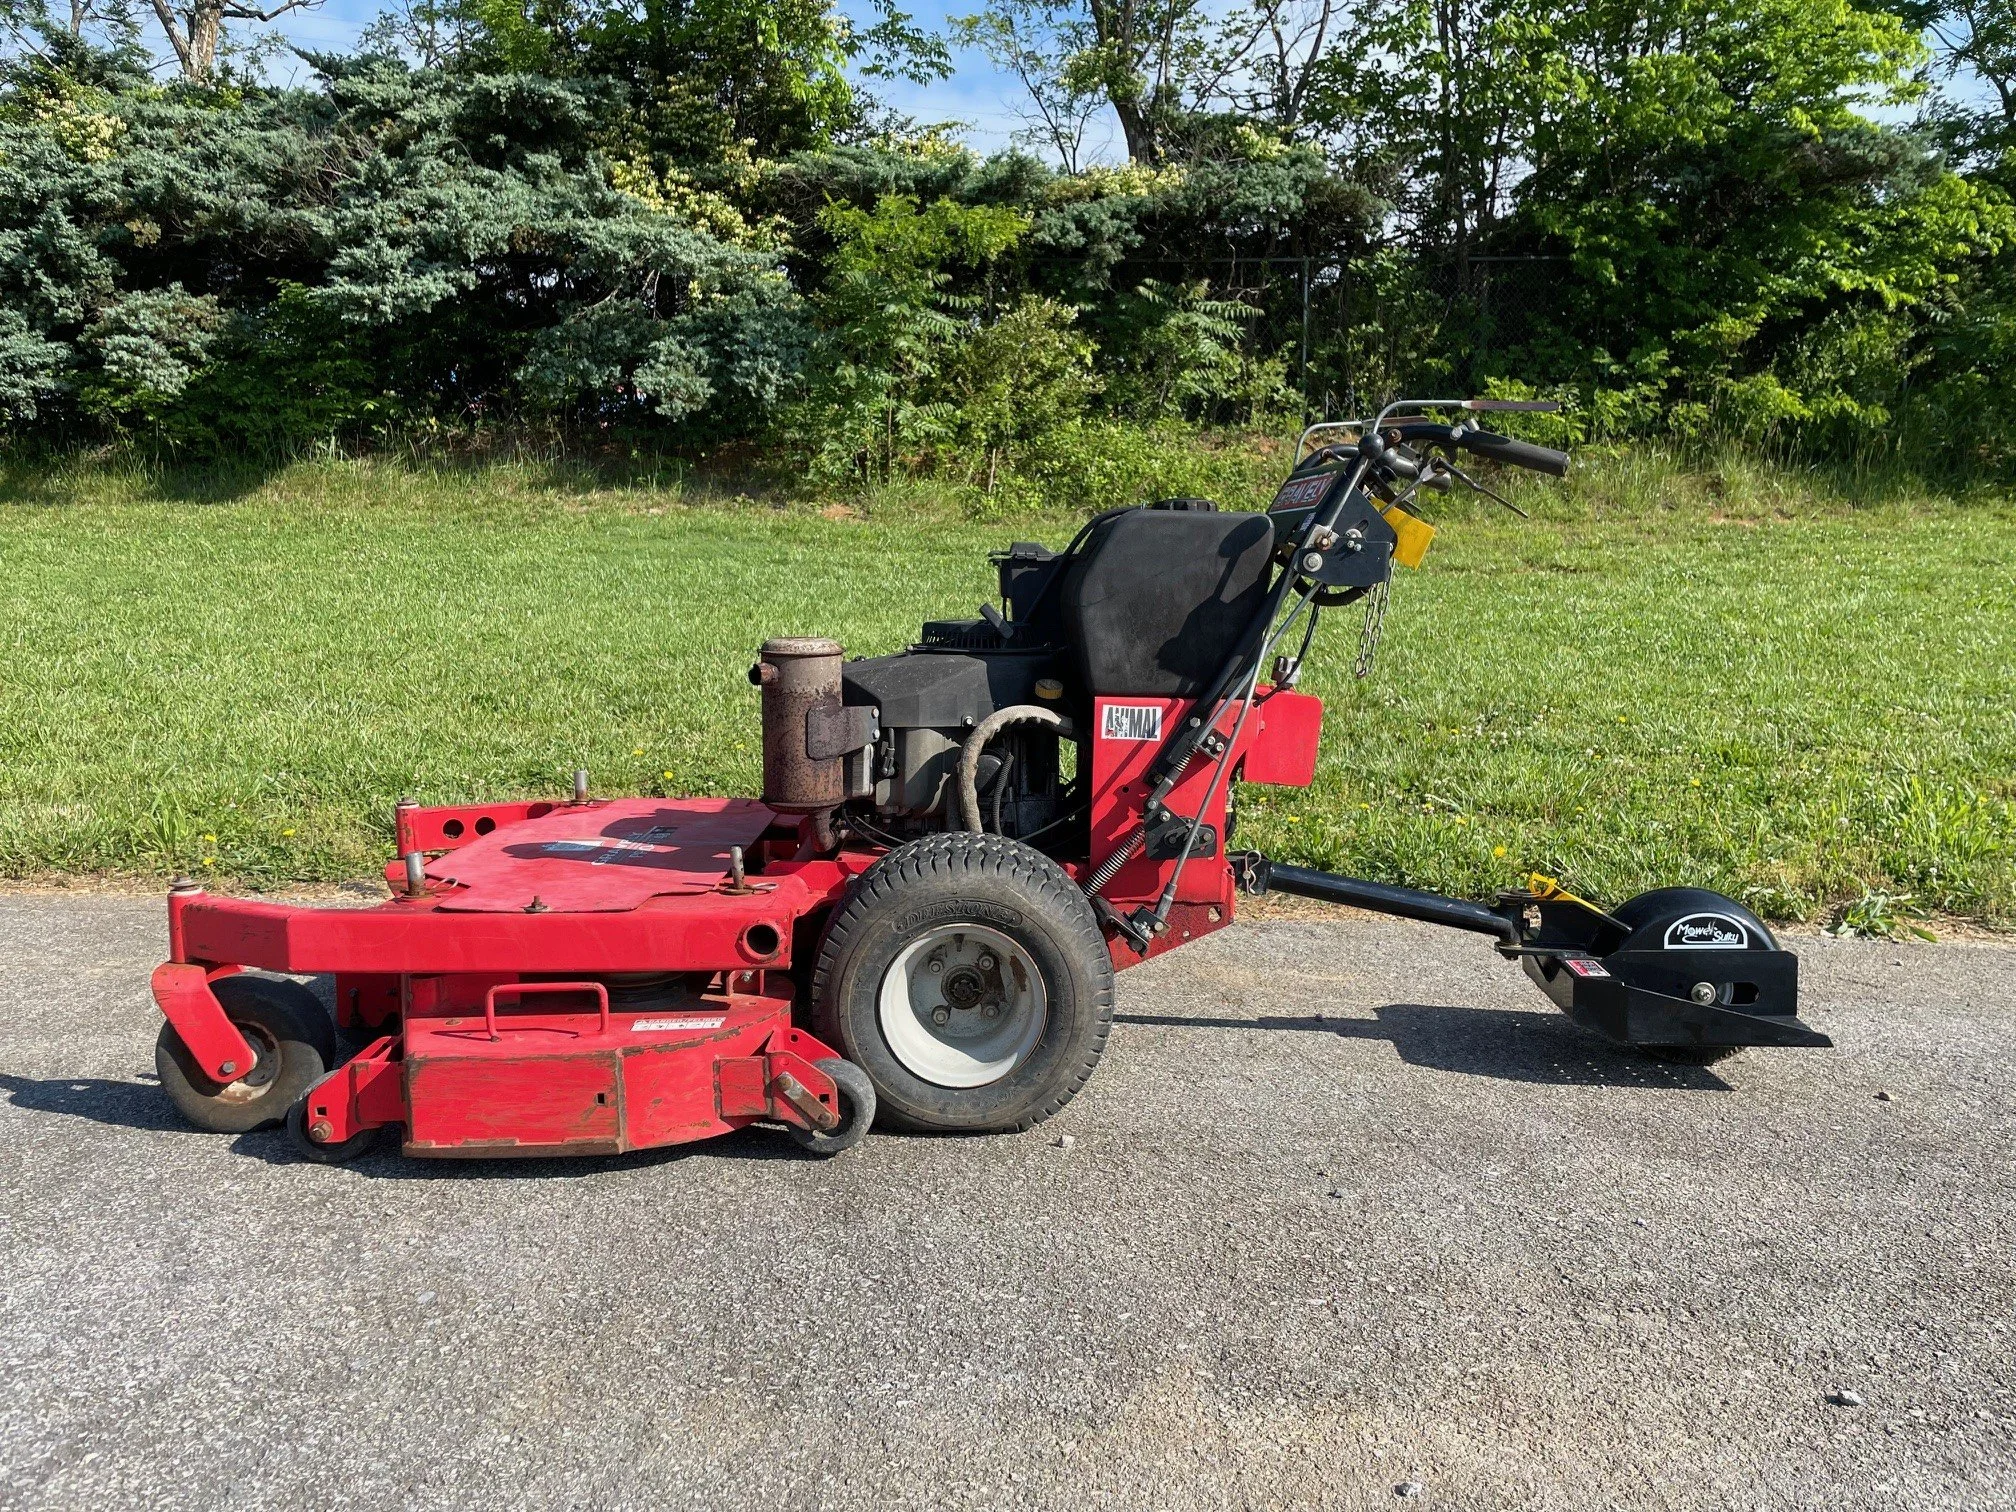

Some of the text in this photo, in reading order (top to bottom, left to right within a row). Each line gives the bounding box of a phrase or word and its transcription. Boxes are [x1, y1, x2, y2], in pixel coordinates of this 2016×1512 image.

[1274, 477, 1334, 507] GRAVELY
[1104, 706, 1158, 738] ANIMAL
[1712, 930, 1739, 944] Sulky
